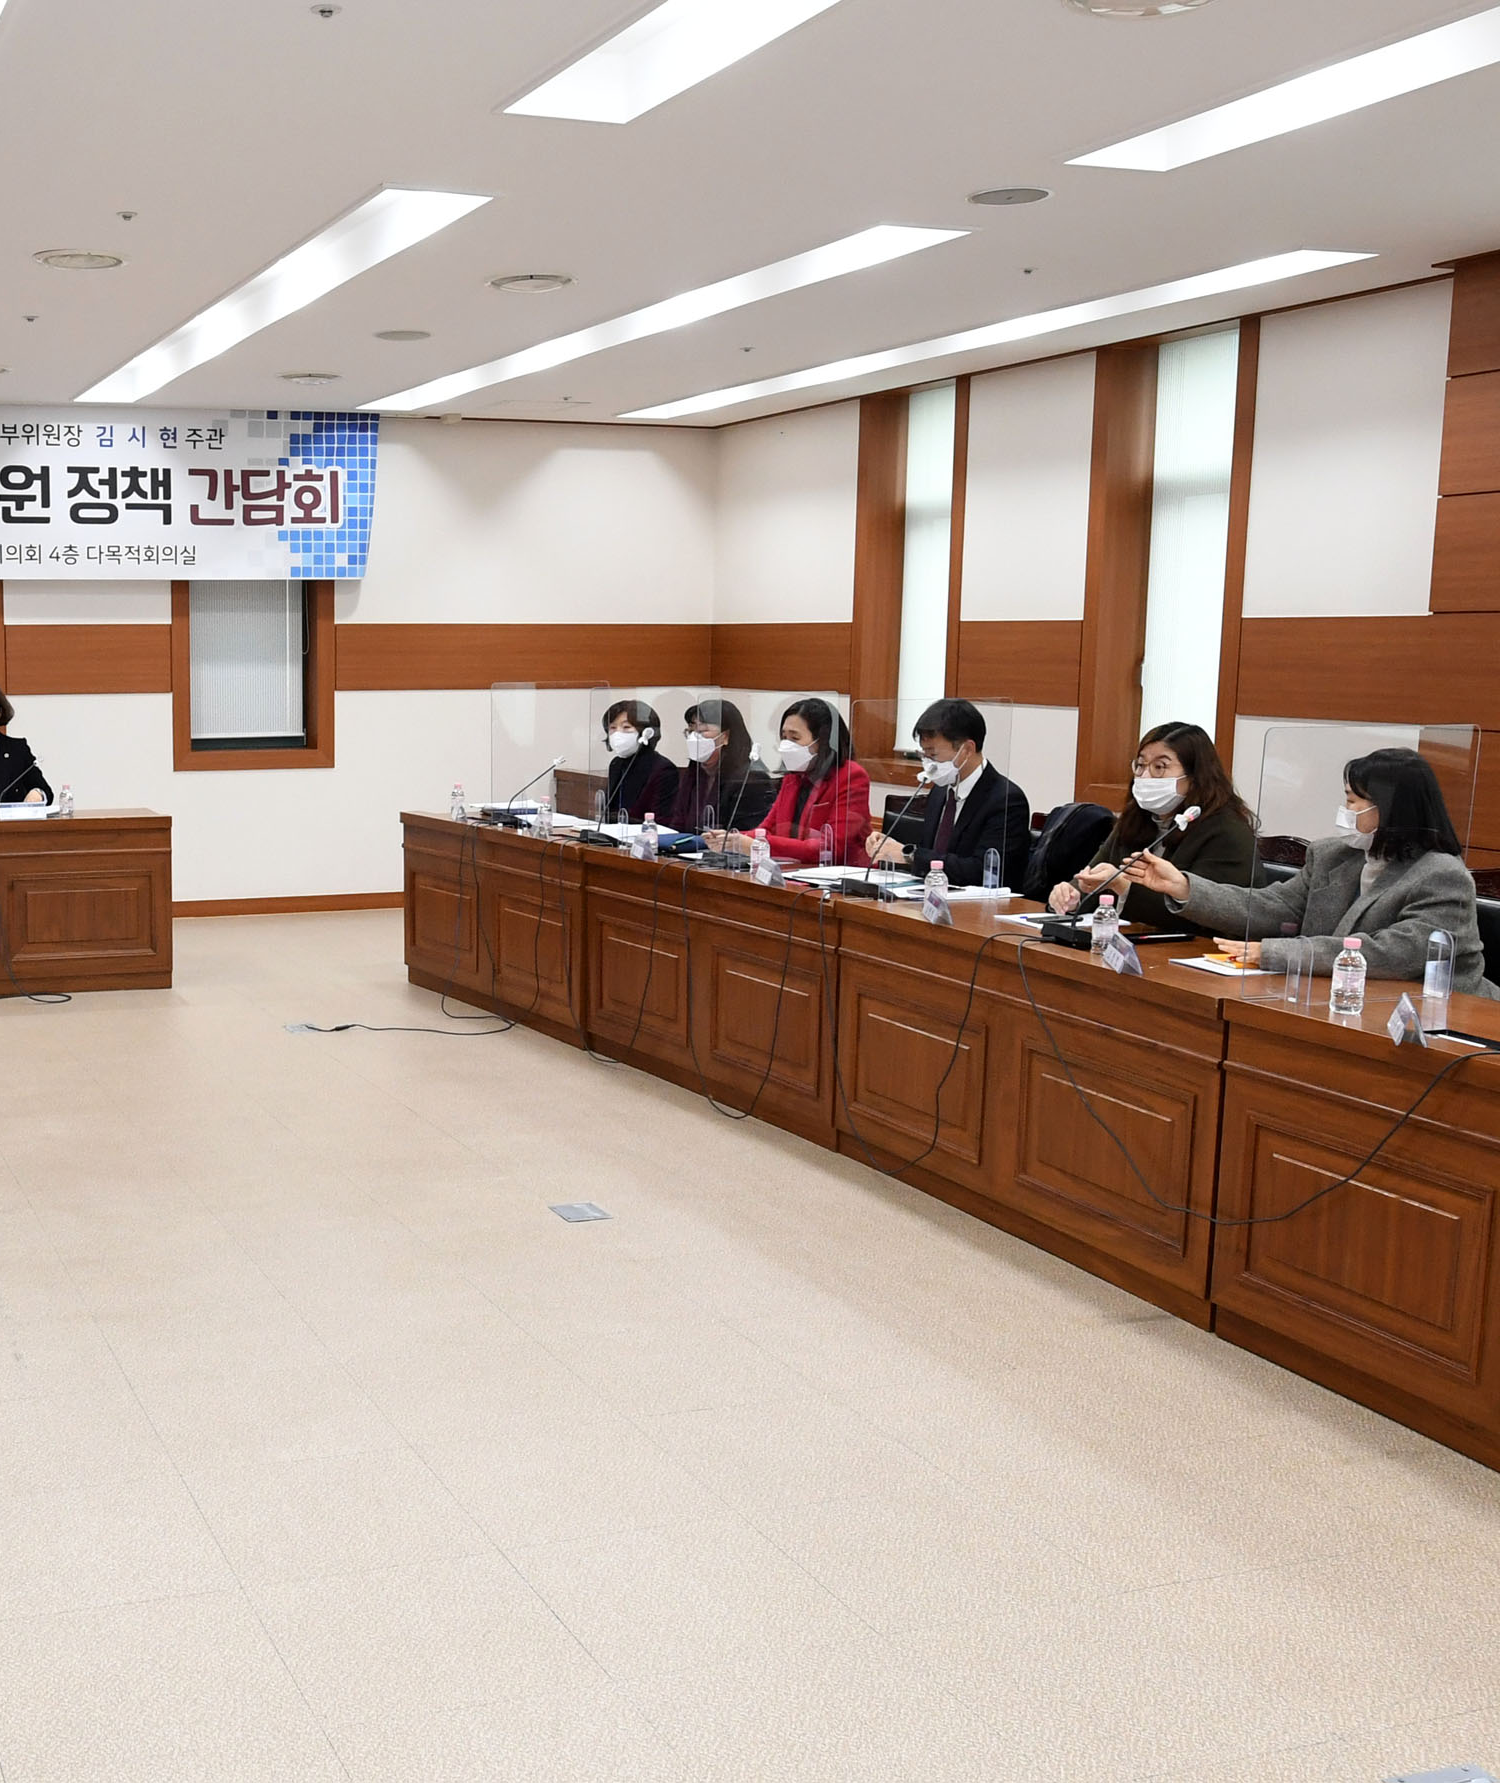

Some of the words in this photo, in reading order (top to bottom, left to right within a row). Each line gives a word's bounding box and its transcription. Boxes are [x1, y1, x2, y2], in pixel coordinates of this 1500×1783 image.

[0, 423, 83, 449] 부위원장
[184, 427, 226, 451] 주관
[66, 466, 172, 526] 정책
[188, 468, 340, 527] 간담회
[49, 544, 80, 566] 4층
[86, 545, 197, 567] 다목적회의실
